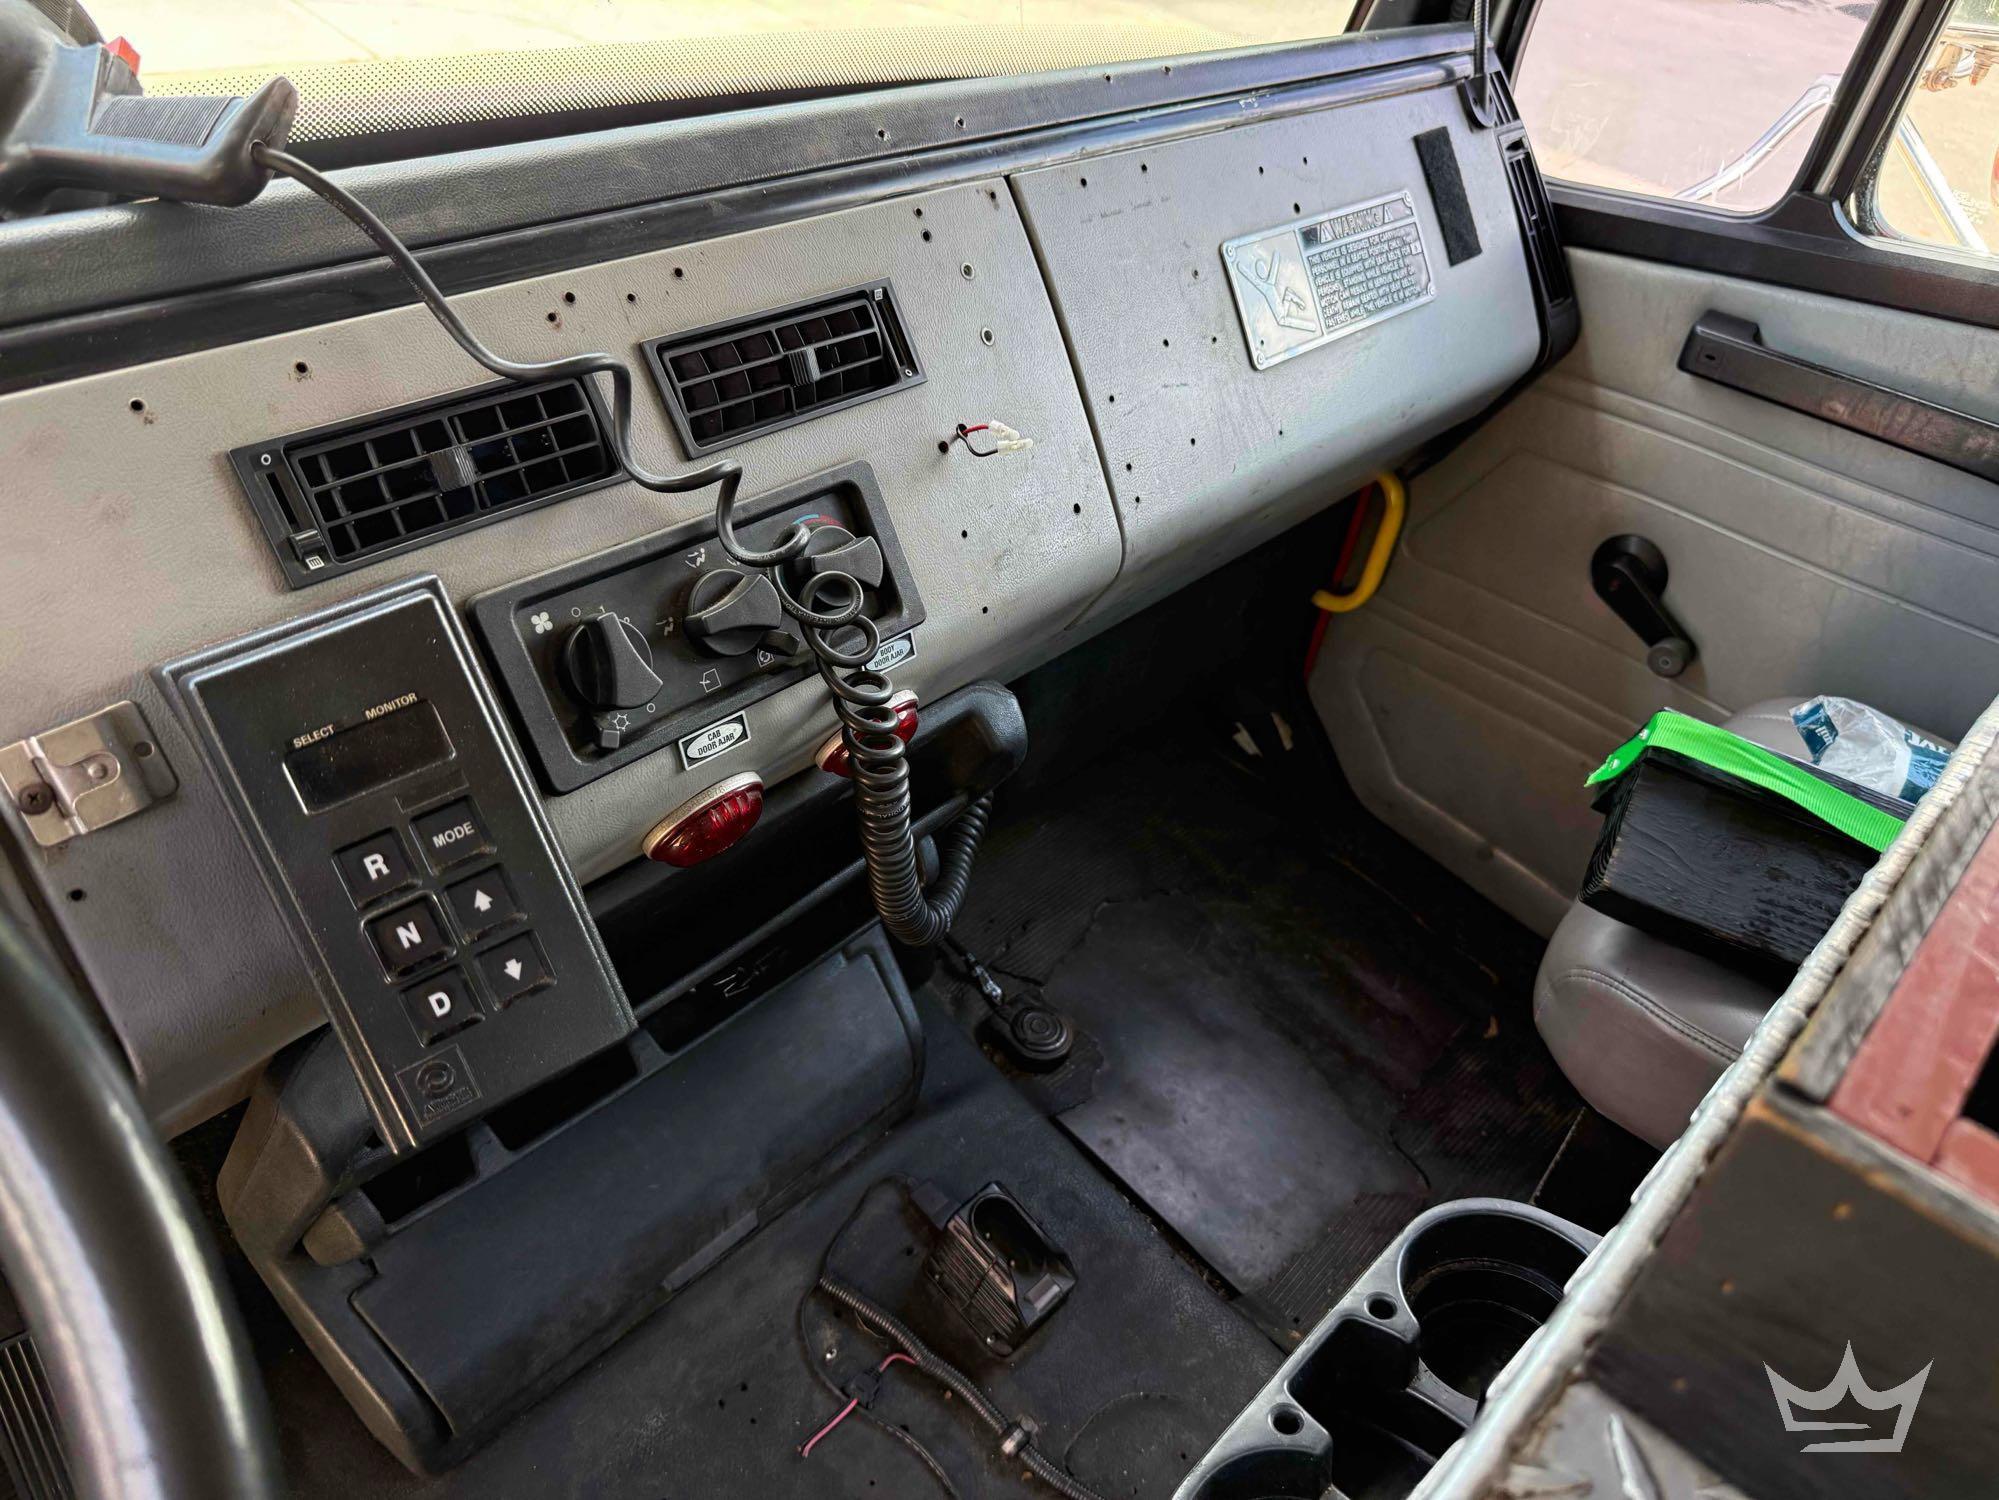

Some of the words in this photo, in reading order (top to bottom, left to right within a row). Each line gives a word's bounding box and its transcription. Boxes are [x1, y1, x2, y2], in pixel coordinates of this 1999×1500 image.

[1330, 208, 1381, 239] WARNING
[1321, 248, 1340, 261] VEHICLE
[1347, 239, 1369, 252] DESIGNED
[1315, 272, 1335, 286] VEHICLE
[1381, 262, 1399, 274] VEHICLE
[1375, 295, 1393, 309] VEHICLE
[873, 655, 890, 668] DOOR
[890, 648, 904, 661] AJAR
[880, 644, 895, 657] BODY
[364, 692, 418, 720] MONITOR
[293, 724, 336, 749] SELECT
[697, 741, 718, 756] DOOR
[718, 732, 735, 747] AJAR
[707, 729, 721, 742] CAB
[432, 821, 475, 849] MODE
[363, 853, 390, 881] R
[396, 921, 422, 949] N
[428, 991, 452, 1018] D
